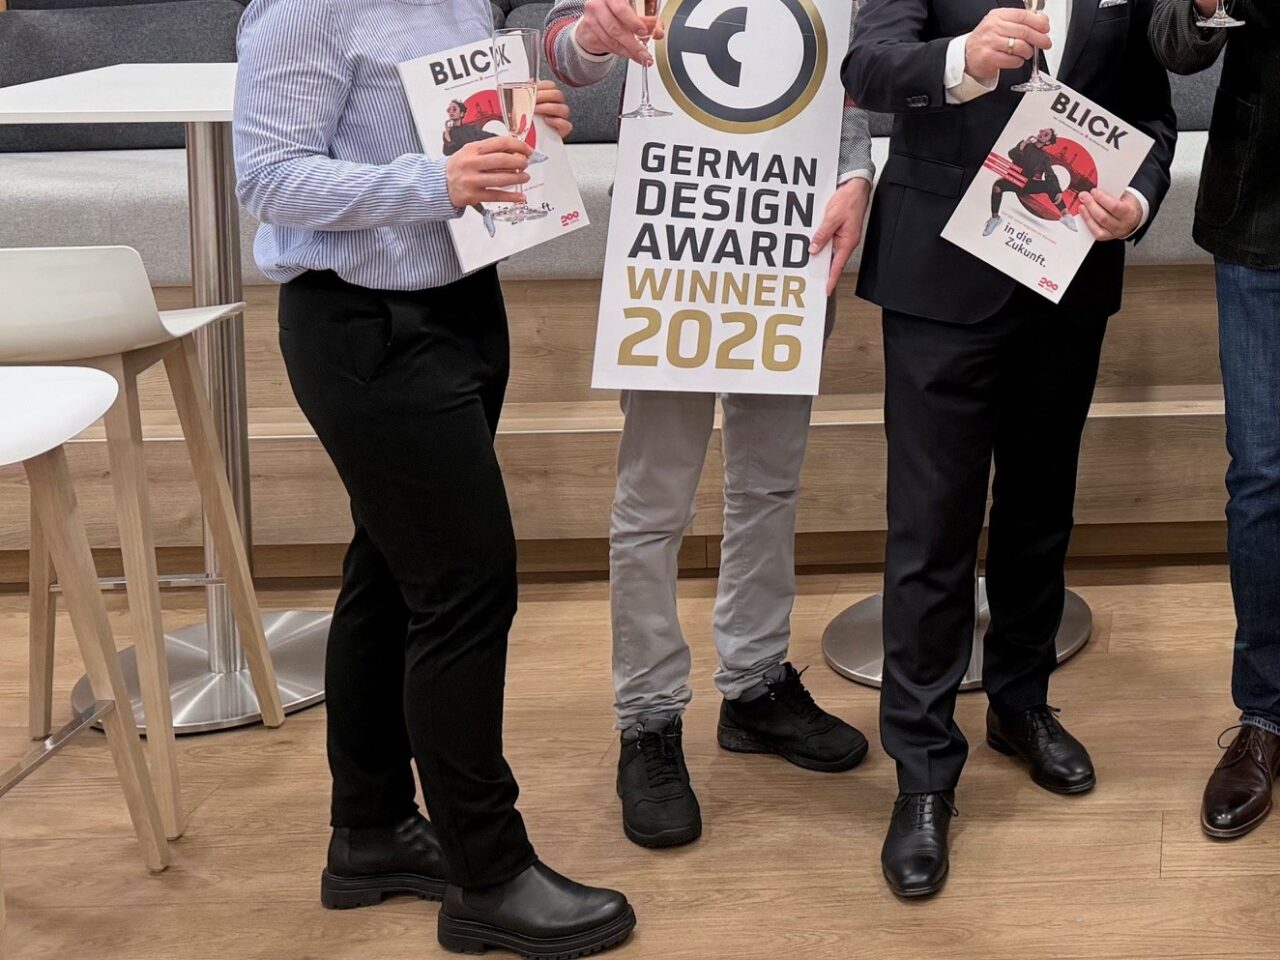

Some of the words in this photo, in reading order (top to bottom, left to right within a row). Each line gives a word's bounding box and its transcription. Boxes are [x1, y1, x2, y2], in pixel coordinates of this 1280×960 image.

[1050, 92, 1129, 150] BLICK
[640, 141, 818, 187] GERMAN
[635, 178, 815, 227] DESIGN
[627, 222, 810, 269] AWARD
[1003, 222, 1015, 236] in
[1016, 231, 1033, 246] die
[1004, 236, 1046, 268] Zukunft.
[626, 265, 807, 308] WINNER
[617, 306, 805, 372] 2026
